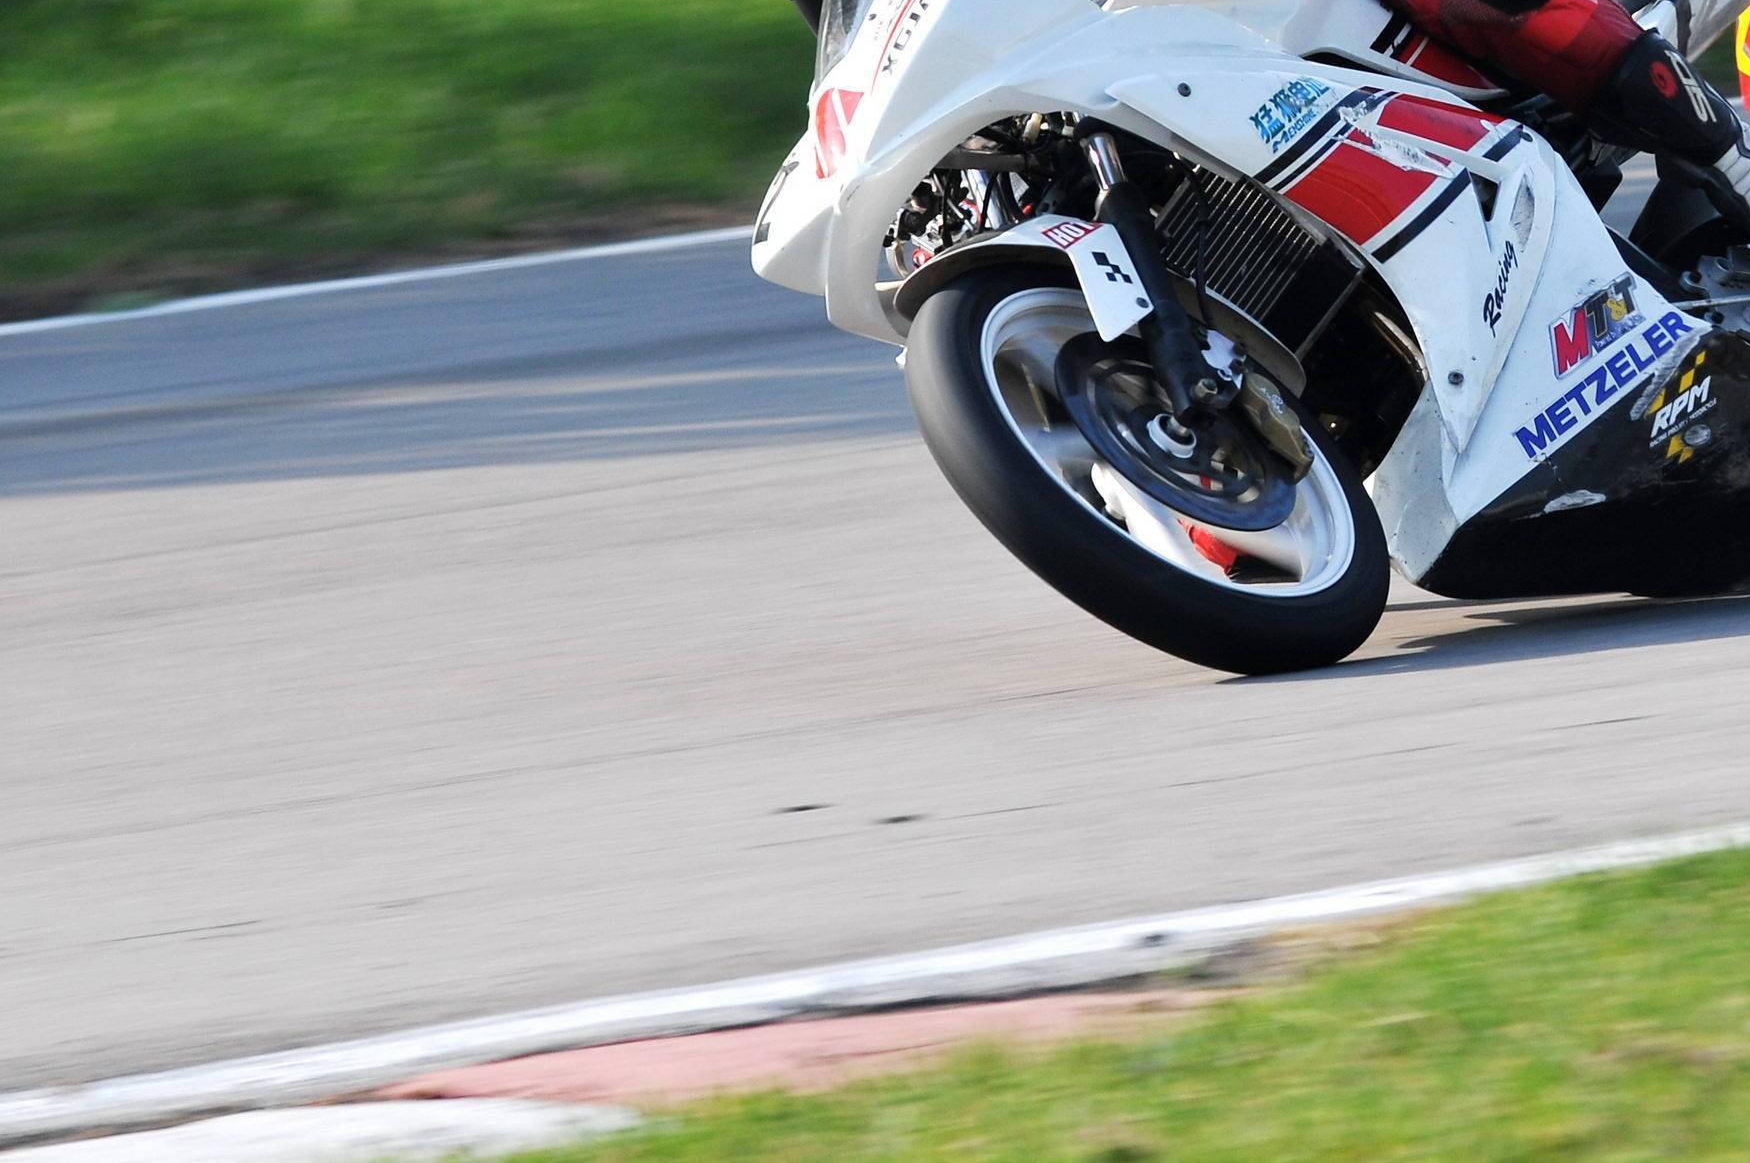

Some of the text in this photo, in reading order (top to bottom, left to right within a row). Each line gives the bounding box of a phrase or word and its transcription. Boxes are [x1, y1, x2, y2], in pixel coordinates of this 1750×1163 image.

[1483, 241, 1519, 338] Racing
[1514, 311, 1693, 459] METZELER
[1650, 374, 1712, 439] RPM
